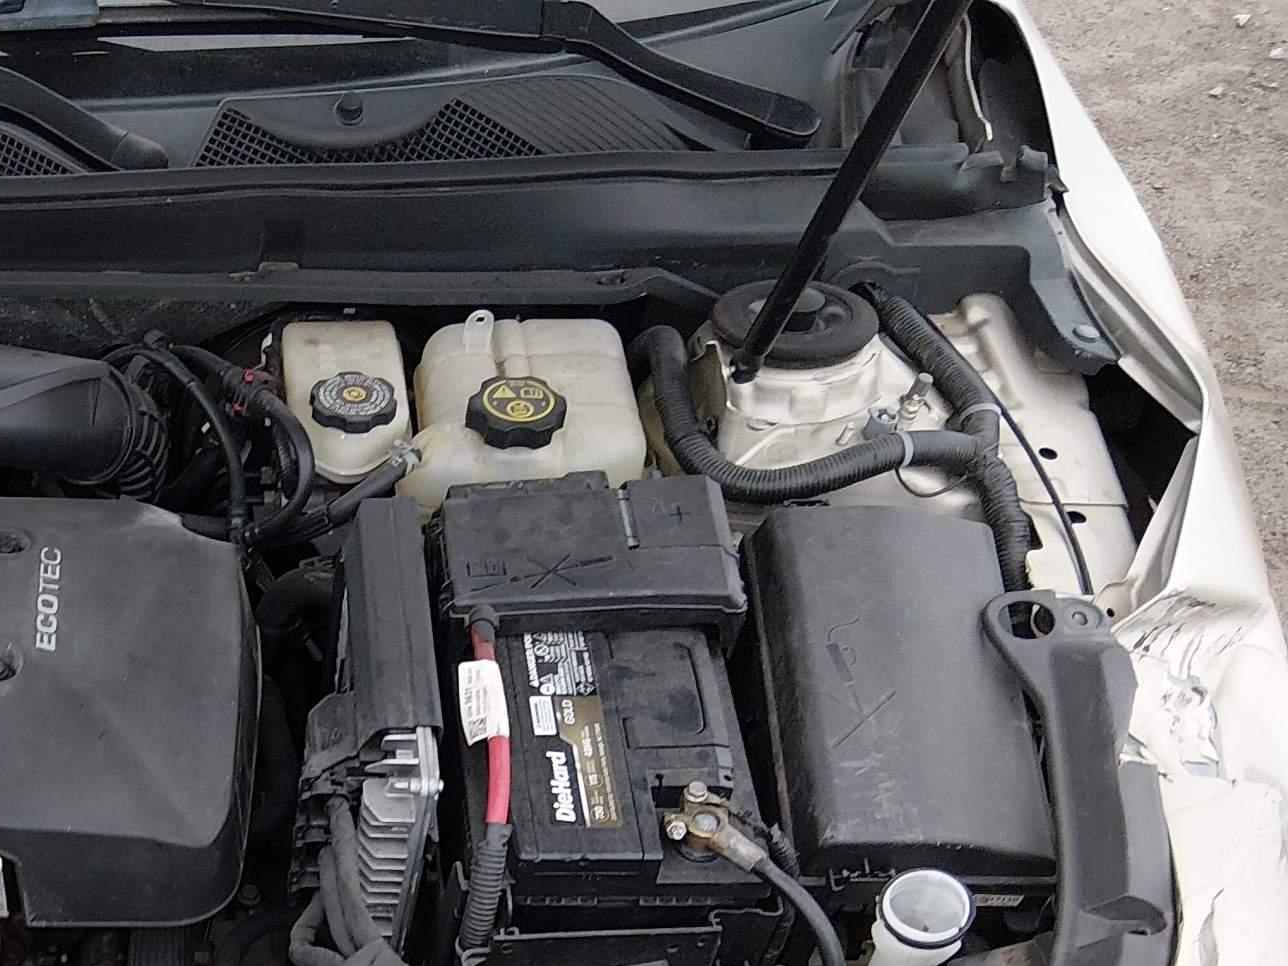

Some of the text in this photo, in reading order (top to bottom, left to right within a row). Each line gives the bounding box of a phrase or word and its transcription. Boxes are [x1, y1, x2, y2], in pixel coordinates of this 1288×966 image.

[35, 547, 62, 652] ECOTEC
[562, 699, 575, 725] GOLD
[545, 750, 577, 822] DieHard
